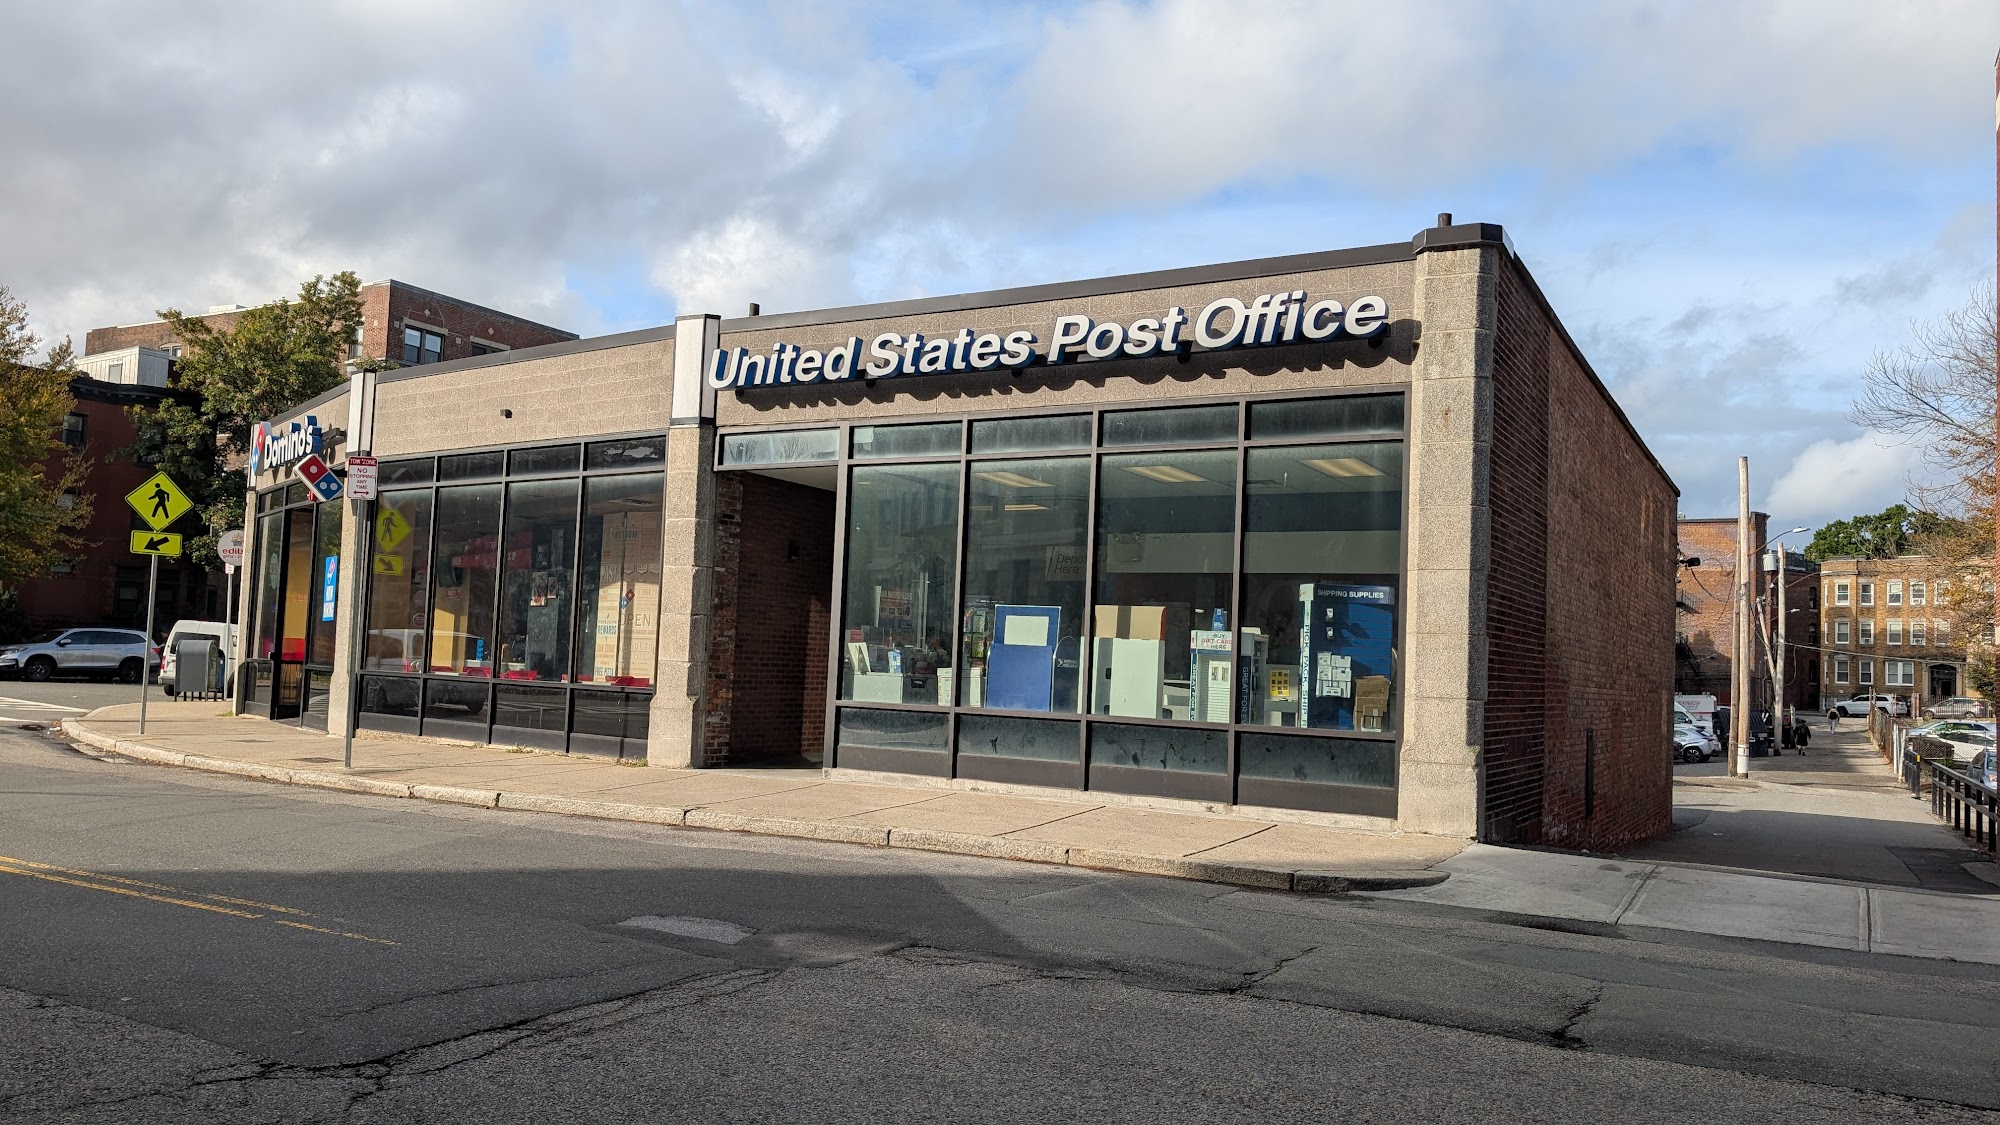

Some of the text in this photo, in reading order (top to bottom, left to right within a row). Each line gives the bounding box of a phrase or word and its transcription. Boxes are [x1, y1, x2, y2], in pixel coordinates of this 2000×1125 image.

[708, 290, 1388, 389] United States Post Office
[264, 416, 320, 470] Domino's
[222, 547, 243, 555] edib
[1054, 563, 1080, 574] Here
[1317, 589, 1348, 598] SHIPPING
[1348, 591, 1384, 599] SUPPLIES
[620, 613, 652, 627] OPEN
[597, 625, 617, 635] REWARDS
[1241, 666, 1249, 693] GREAT
